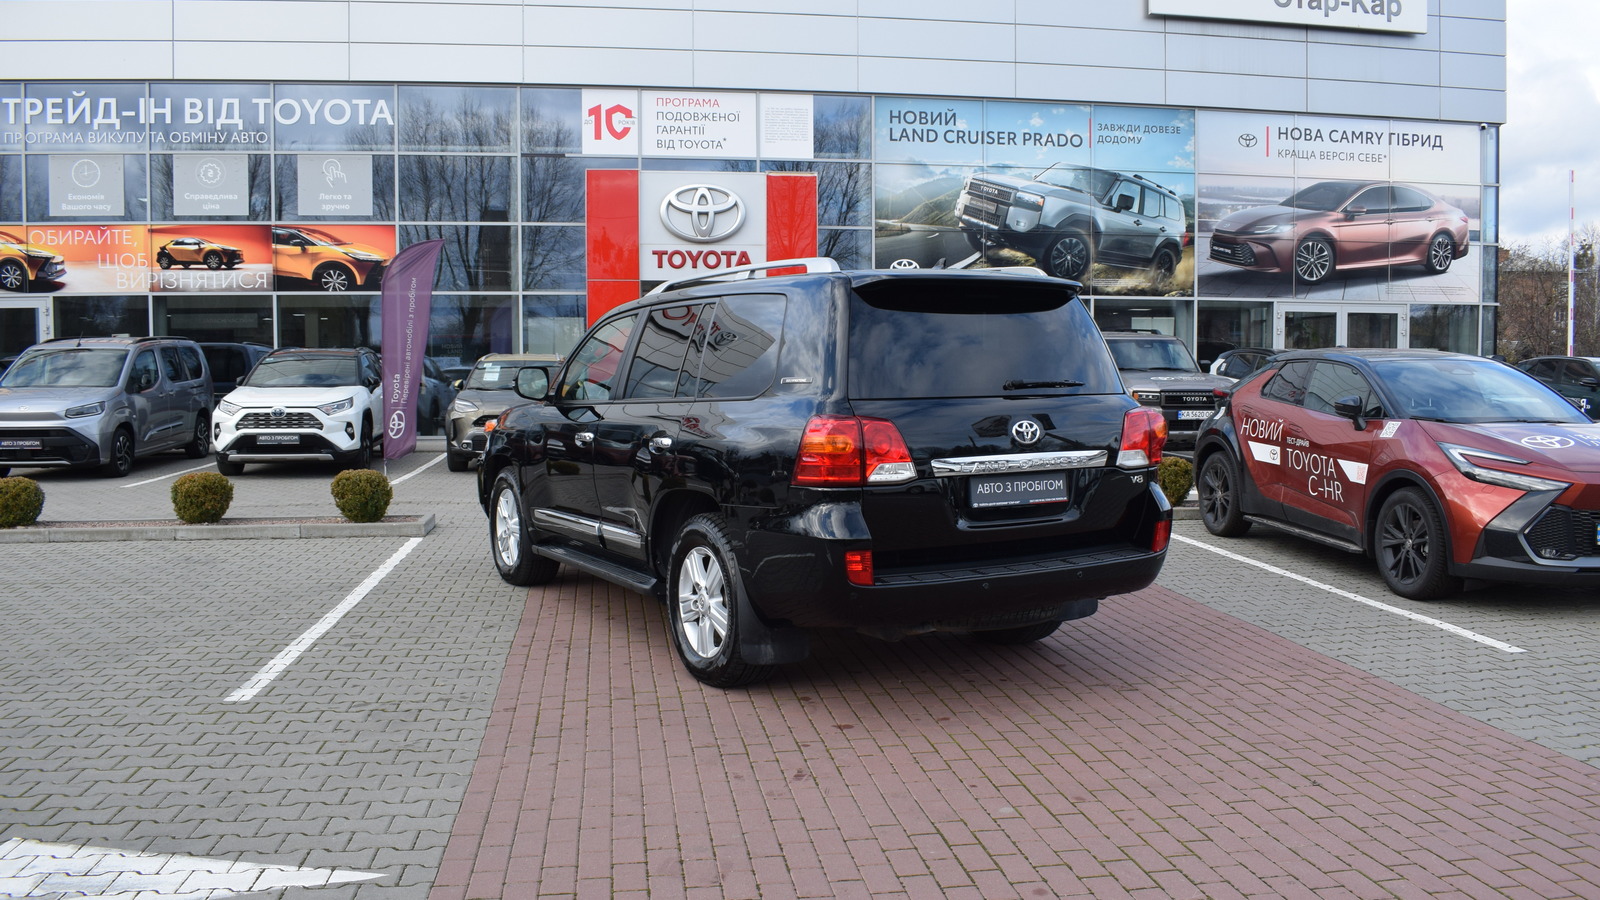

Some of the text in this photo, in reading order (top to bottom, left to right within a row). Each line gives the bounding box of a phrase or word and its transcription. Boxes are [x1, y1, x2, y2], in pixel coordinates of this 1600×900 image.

[656, 97, 720, 108] ПРОГРАМА
[3, 91, 395, 131] ТРЕЙД-ІН ВІД TOYOTA
[656, 111, 740, 123] ПОДОВЖЕНОЇ
[889, 109, 957, 126] НОВИЙ
[656, 125, 705, 136] ГАРАНТІЇ
[1097, 123, 1181, 135] ЗАВЖДИ ДОВЕЗЕ
[4, 131, 268, 144] ПРОГРАМА ВИКУПУ ТА ОБМІНУ АВТО
[656, 139, 675, 150] ВІД
[889, 128, 1083, 148] LAND CRUISER PRADO
[1097, 134, 1143, 145] ДОДОМУ
[1278, 127, 1444, 151] НОВА CAMRY ГІБРИД
[1277, 149, 1316, 161] КРАЩА
[1319, 151, 1355, 162] ВЕРСІЯ
[67, 193, 105, 201] Економія
[184, 192, 238, 202] Справедлива
[319, 193, 340, 201] Легко
[61, 203, 111, 212] Вашого часу
[202, 202, 220, 212] ціна
[321, 204, 350, 212] зручно
[29, 226, 138, 248] ОБИРАЙТЕ,
[97, 253, 148, 270] ЩОБ
[652, 250, 752, 269] TOYOTA
[117, 272, 268, 290] ВИРІЗНЯТИСЯ
[408, 277, 417, 313] пробігом
[406, 319, 414, 361] автомобілі
[391, 374, 401, 404] Toyota
[401, 362, 412, 404] Перевірені
[1240, 418, 1284, 442] НОВИЙ
[960, 456, 1089, 473] LAND CRUISER
[1286, 448, 1337, 478] TOYOTA
[977, 481, 1003, 494] АВТО
[1014, 479, 1063, 492] ПРОБІГОМ
[1130, 475, 1143, 484] V8
[1308, 475, 1344, 502] C-HR
